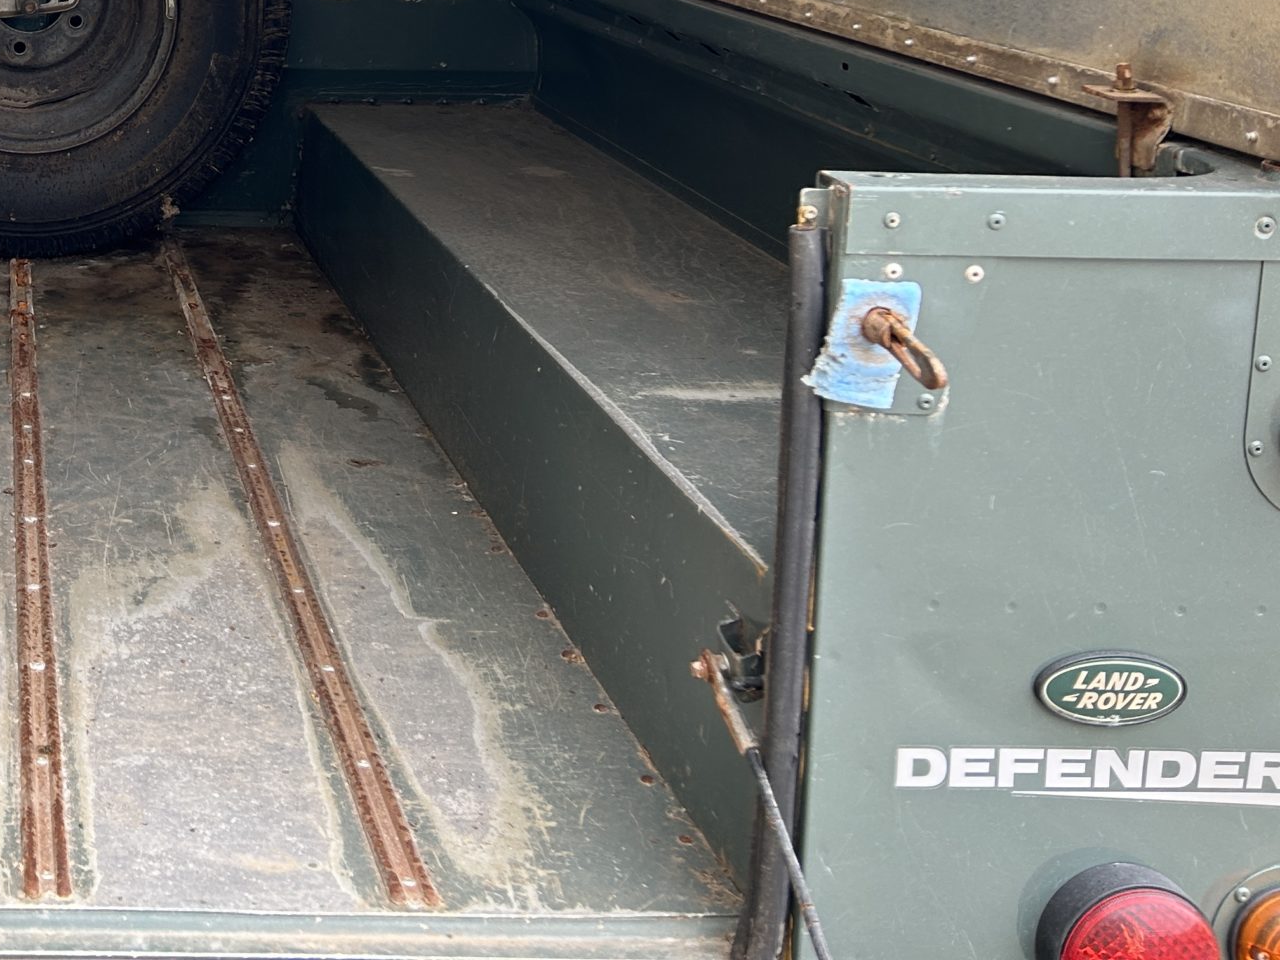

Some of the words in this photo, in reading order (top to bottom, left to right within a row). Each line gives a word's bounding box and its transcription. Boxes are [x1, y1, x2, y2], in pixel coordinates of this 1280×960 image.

[1073, 670, 1145, 691] LAND
[1076, 691, 1163, 710] ROVER
[894, 747, 1280, 790] DEFENDER
